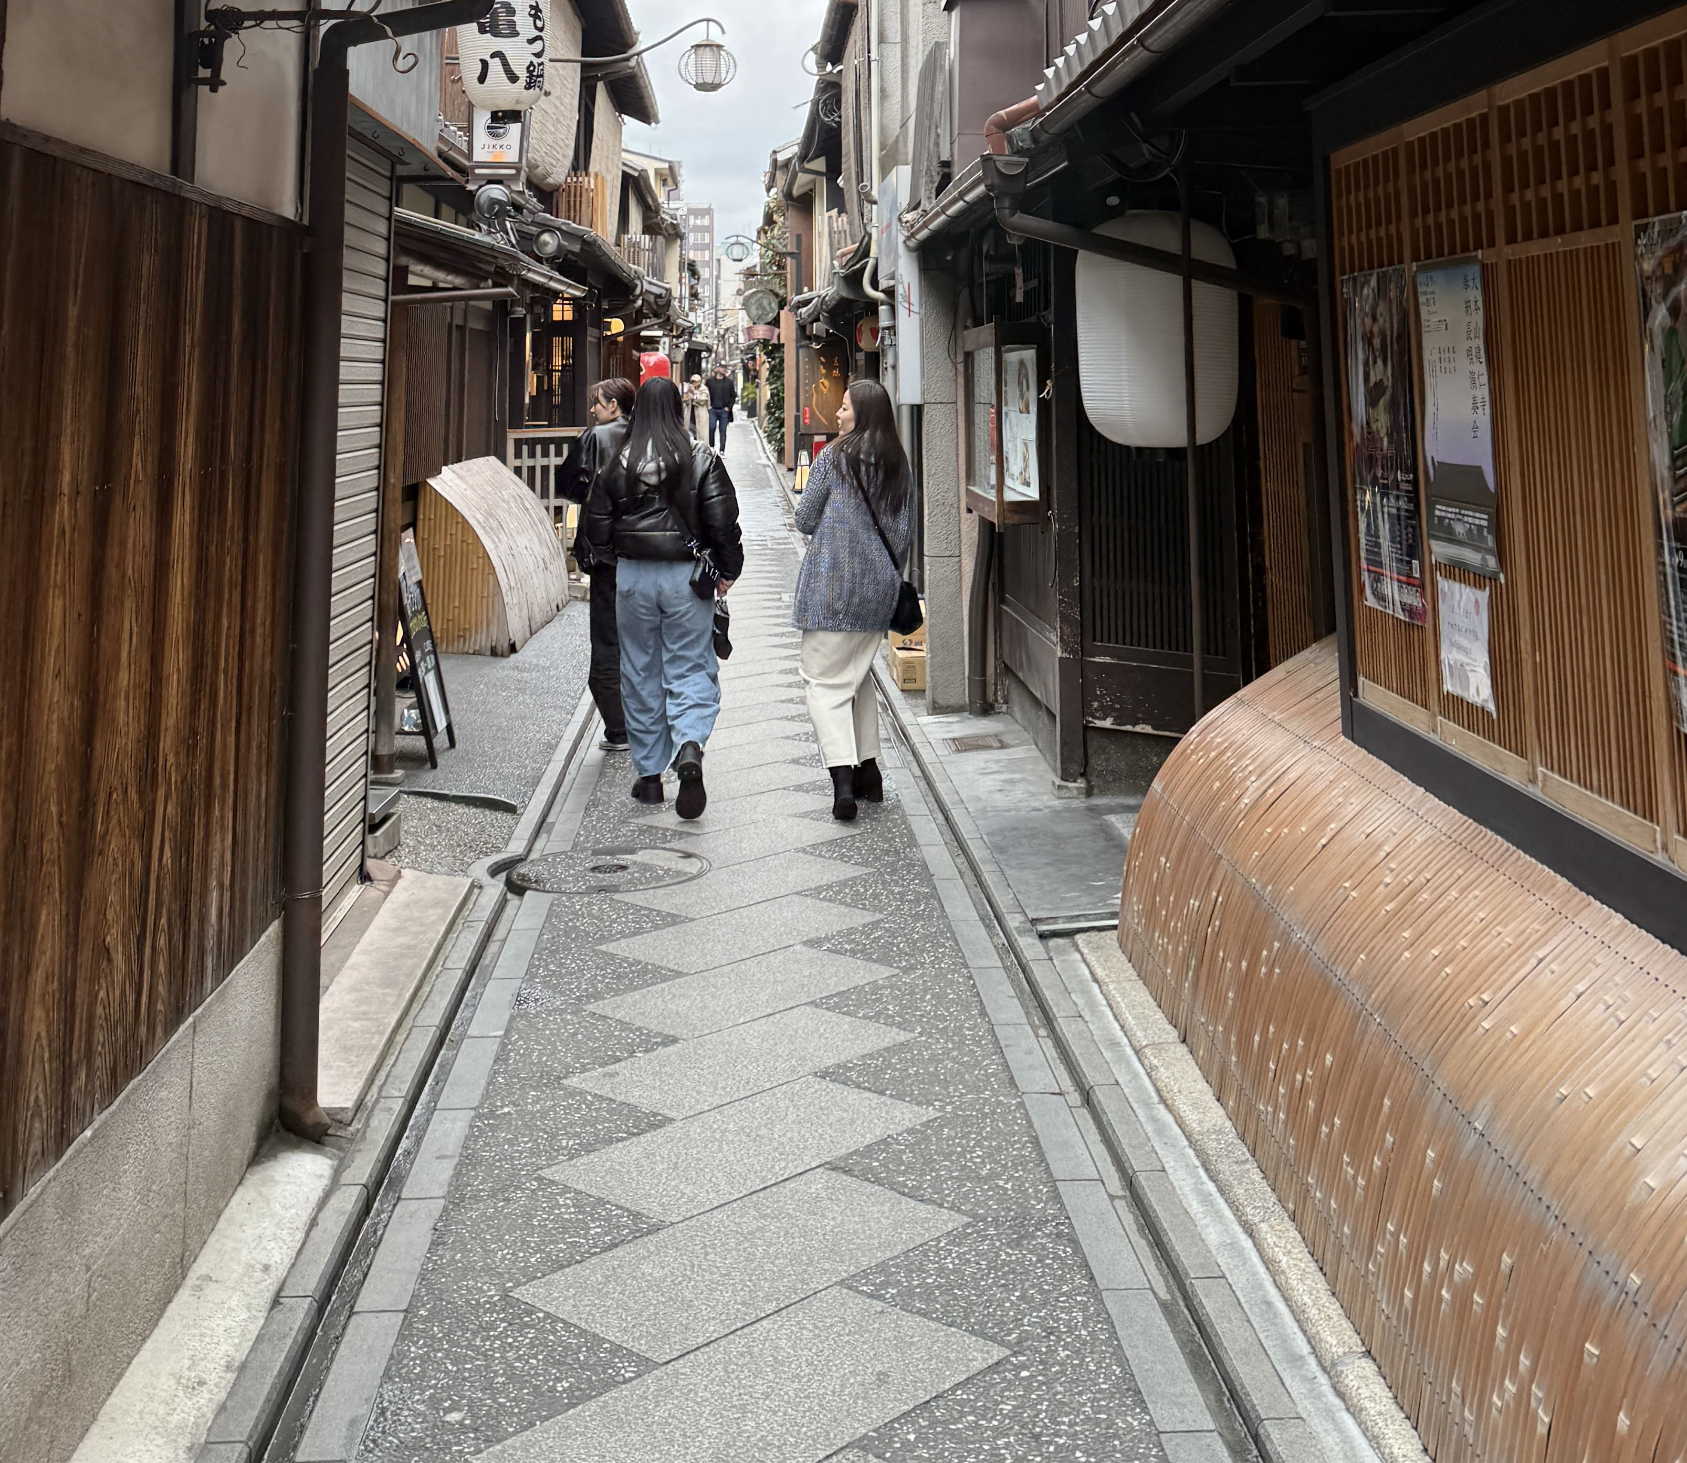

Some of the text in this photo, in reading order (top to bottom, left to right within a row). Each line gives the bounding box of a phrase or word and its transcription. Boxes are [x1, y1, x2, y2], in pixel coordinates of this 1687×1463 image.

[523, 0, 545, 92] もつ鍋
[1471, 271, 1487, 416] 大本山建仁寺
